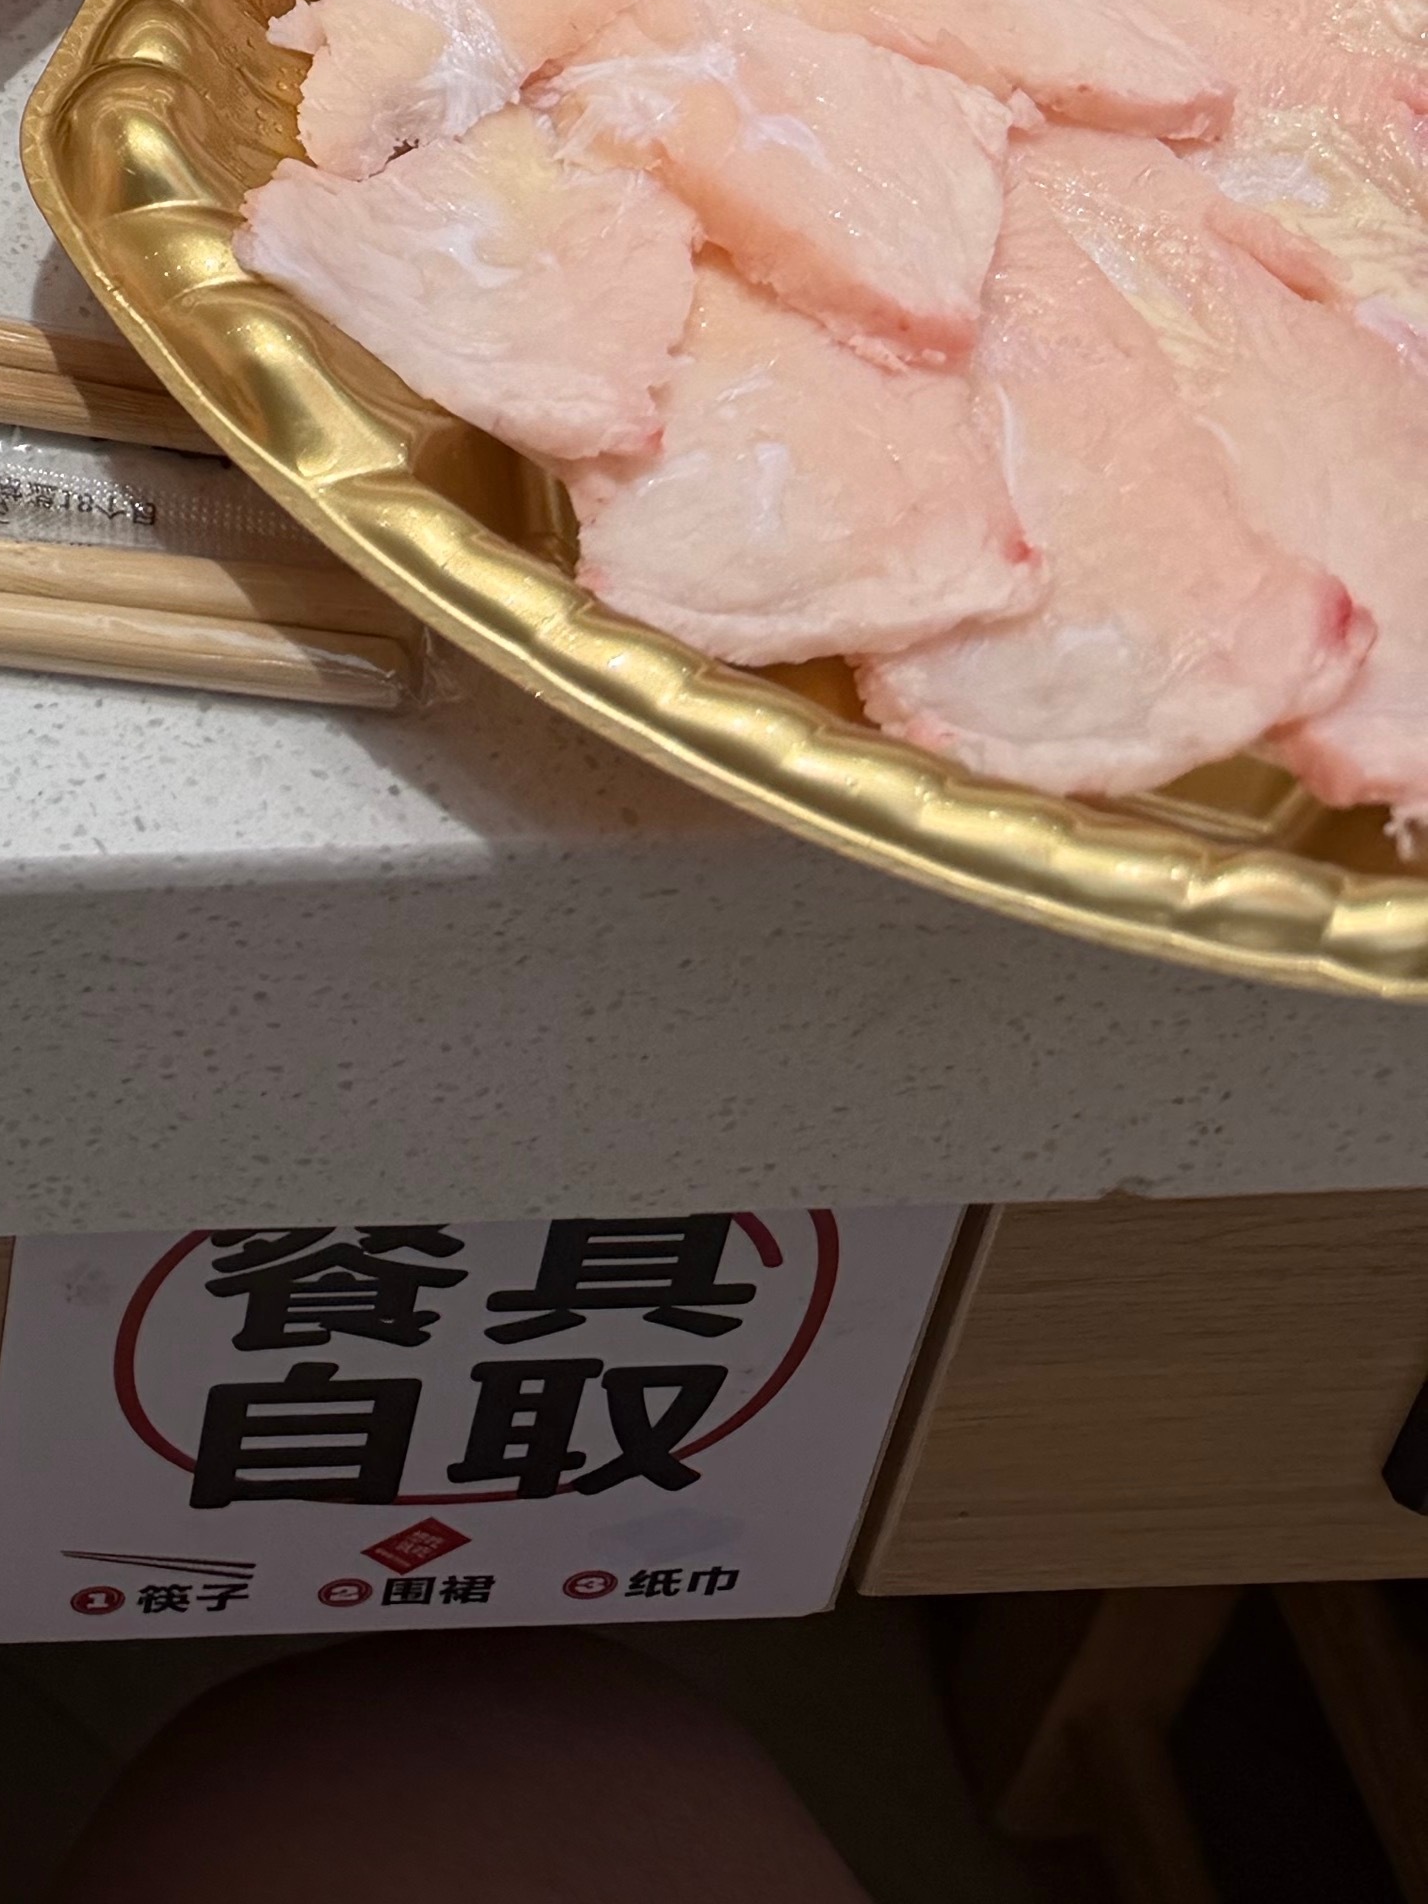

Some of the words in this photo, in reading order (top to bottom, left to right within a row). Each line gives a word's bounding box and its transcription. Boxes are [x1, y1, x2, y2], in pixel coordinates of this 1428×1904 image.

[189, 1358, 729, 1509] 自取
[380, 1574, 496, 1606] 围裙
[624, 1566, 740, 1598] 纸巾
[135, 1583, 250, 1614] 筷子
